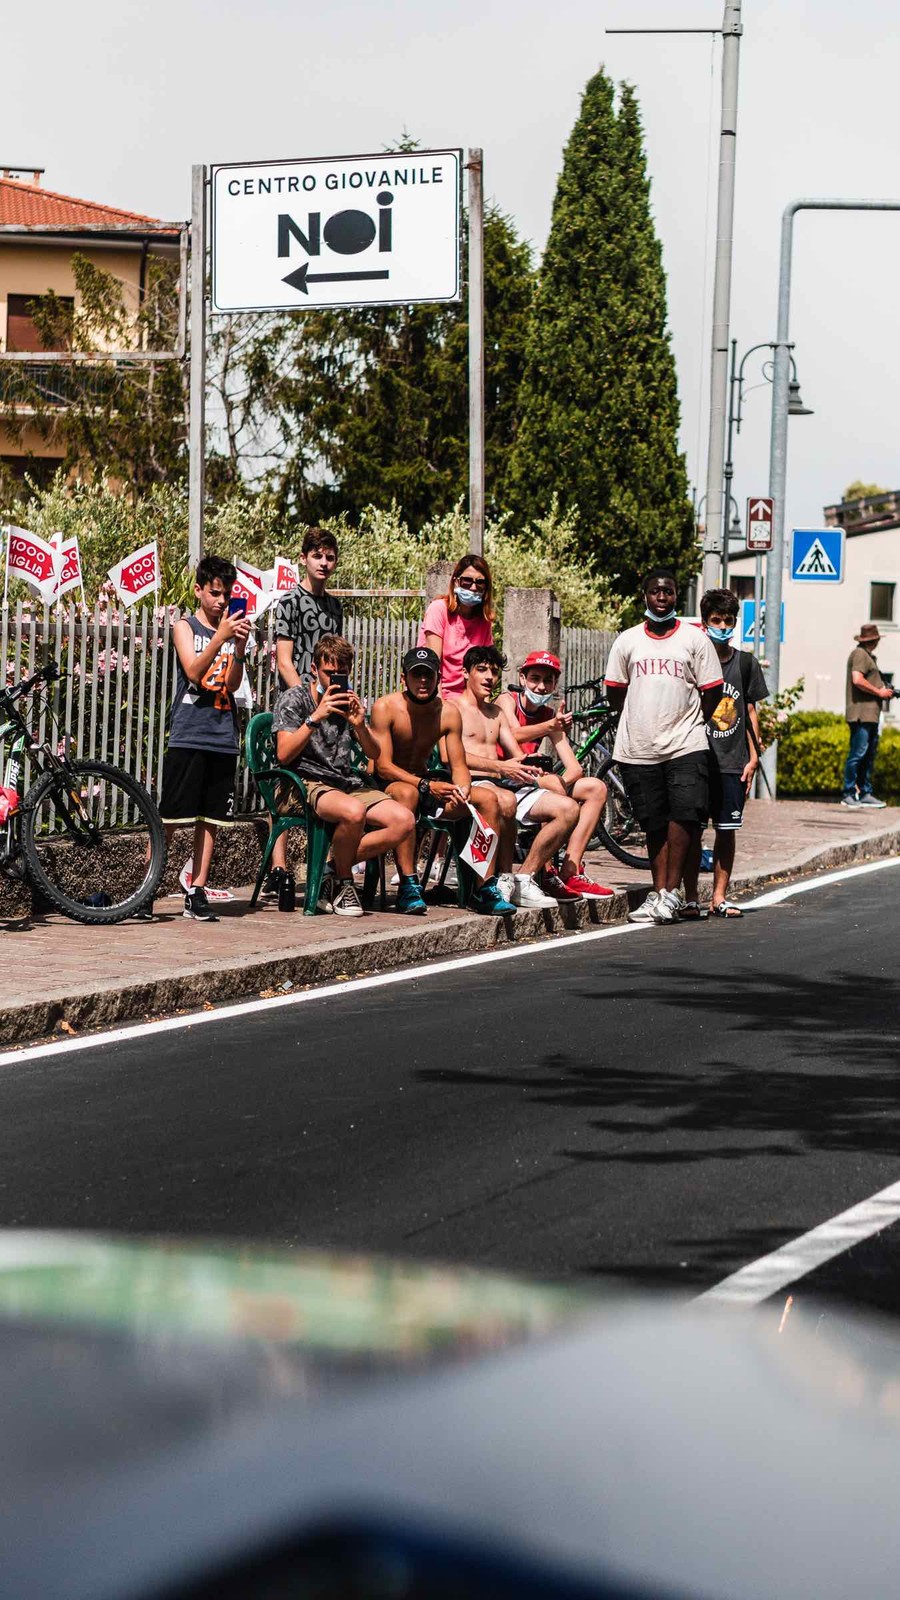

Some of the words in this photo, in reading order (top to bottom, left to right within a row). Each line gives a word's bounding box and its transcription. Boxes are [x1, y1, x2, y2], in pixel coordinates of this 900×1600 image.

[227, 174, 317, 196] CENTRO
[325, 166, 443, 190] GIOVANILE
[11, 539, 45, 563] 1000
[635, 658, 685, 680] NIKE
